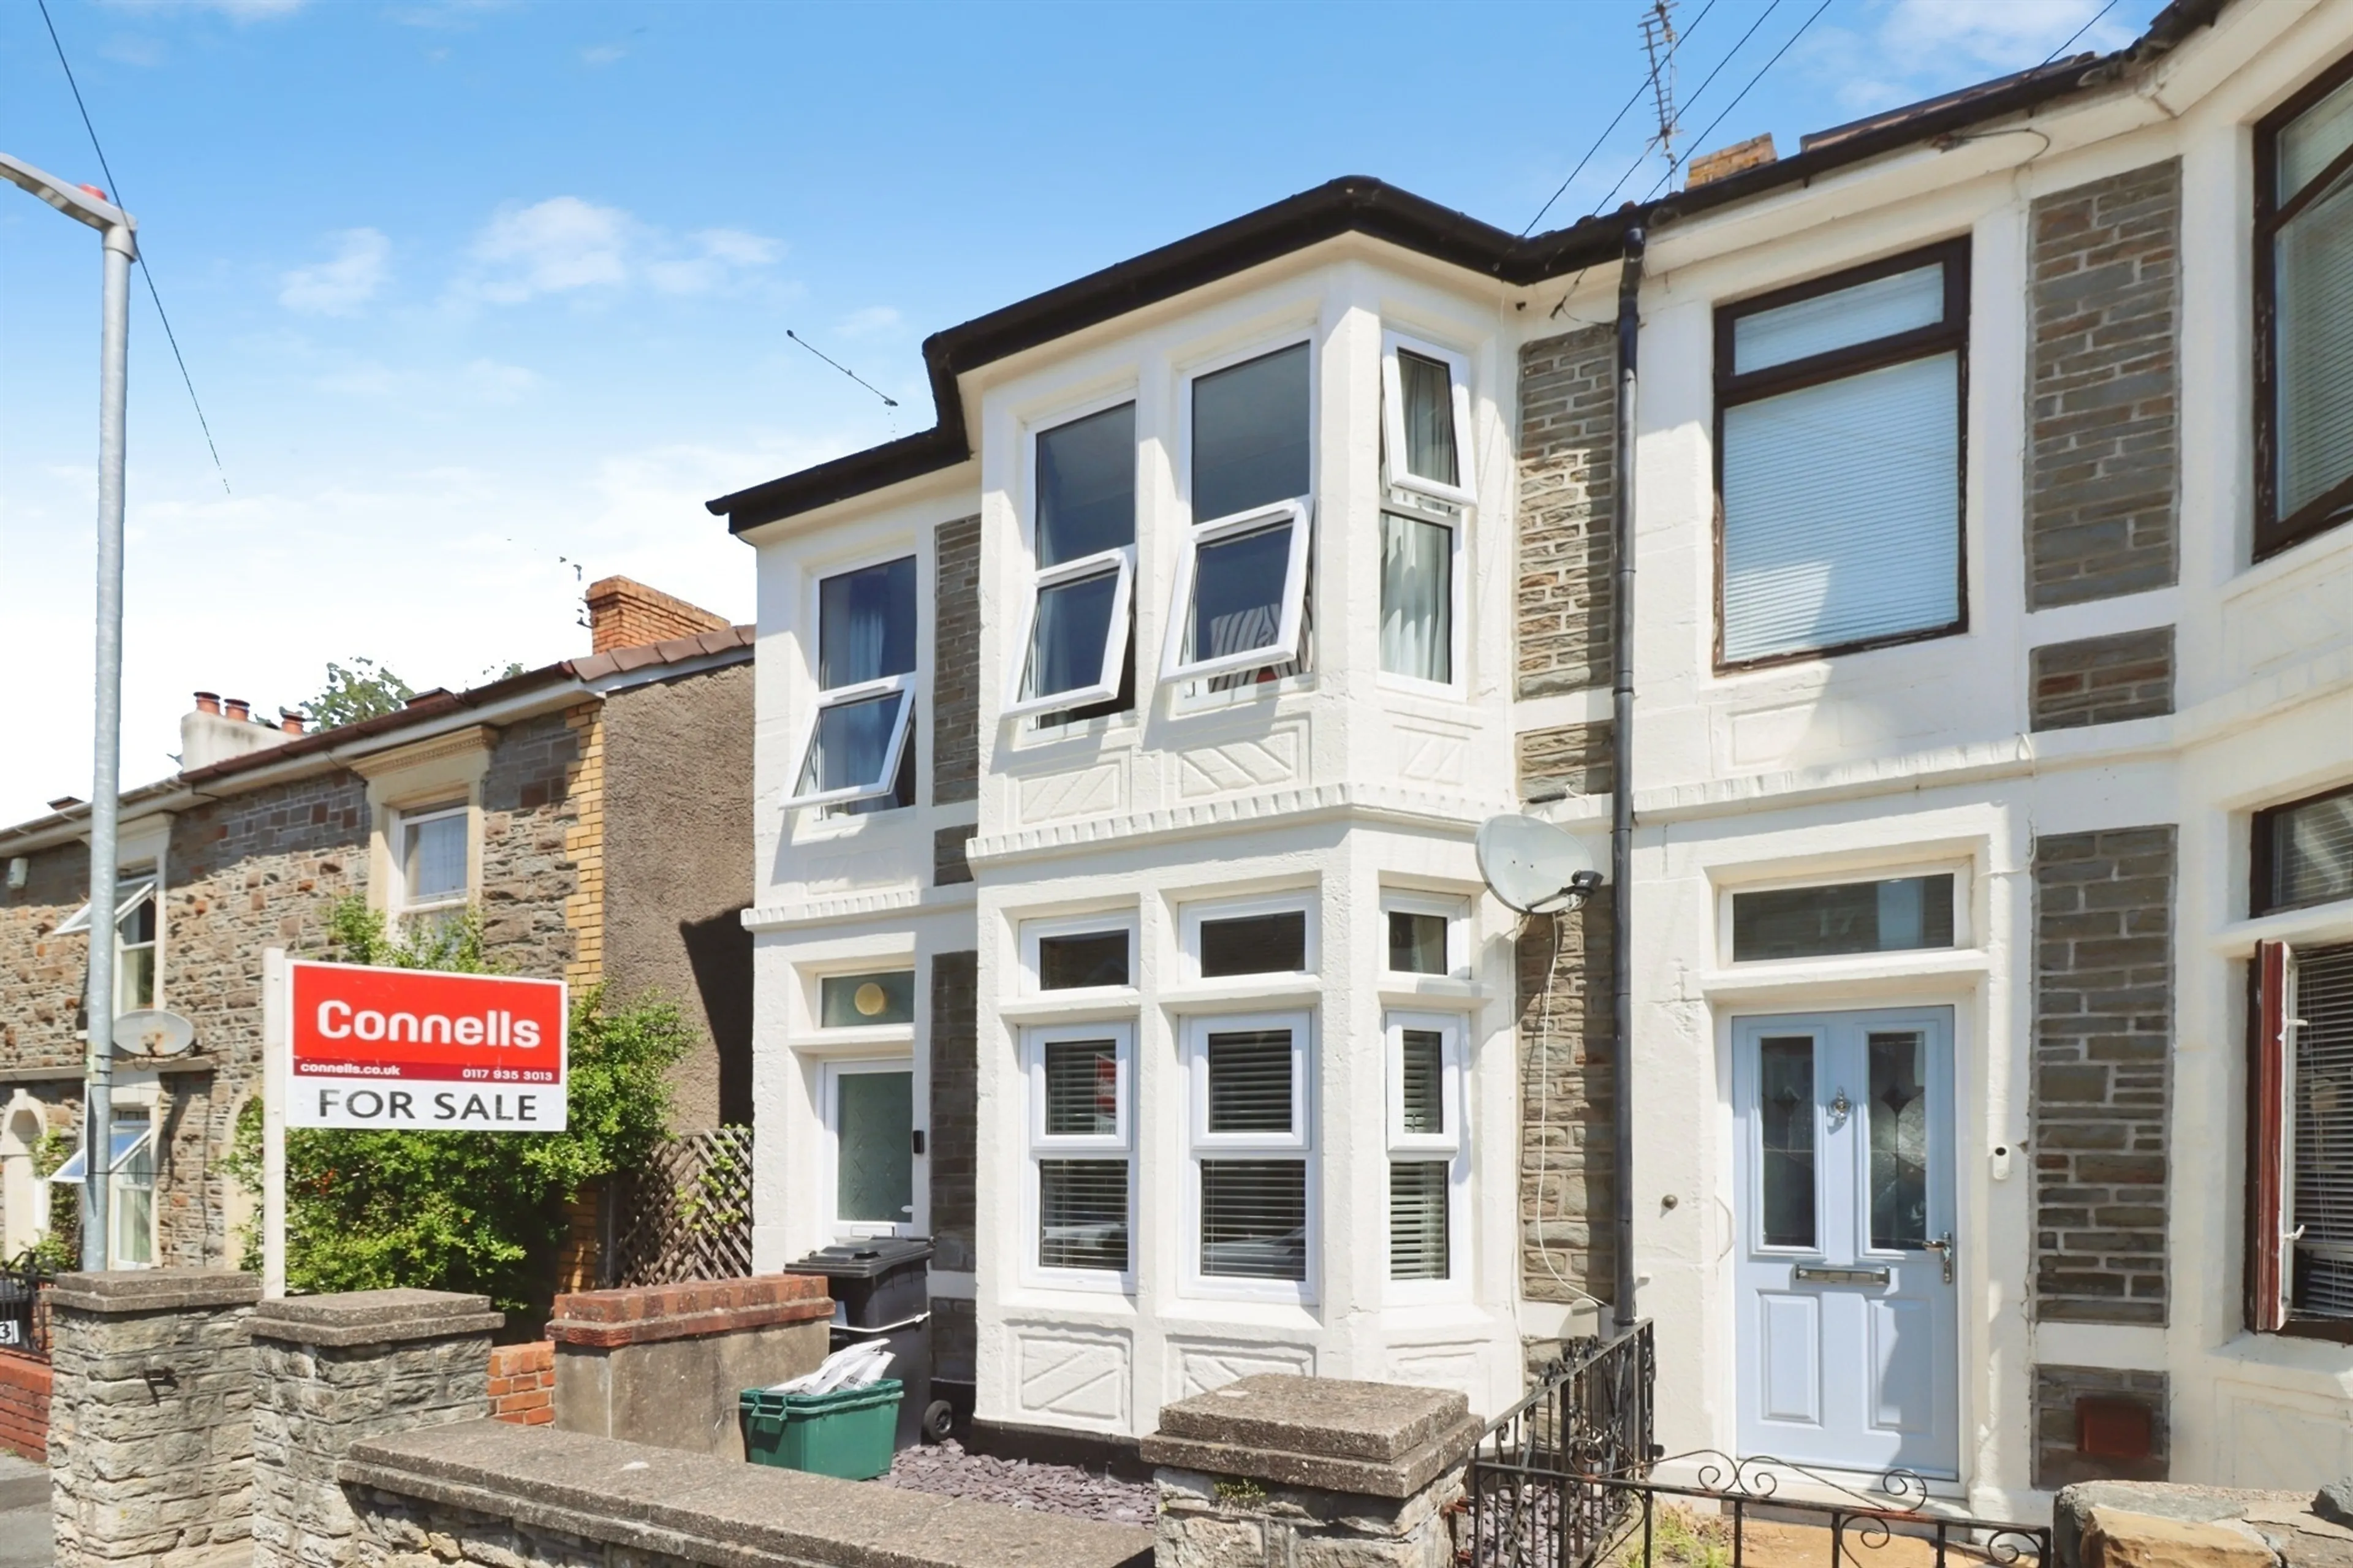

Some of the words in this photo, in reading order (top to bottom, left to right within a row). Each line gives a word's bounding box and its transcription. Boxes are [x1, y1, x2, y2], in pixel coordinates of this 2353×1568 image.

[317, 999, 541, 1048] Connells
[300, 1063, 401, 1075] connells.co.uk
[463, 1068, 489, 1078] 0117
[493, 1069, 519, 1080] 935
[523, 1070, 553, 1081] 3013
[319, 1089, 415, 1119] FOR
[433, 1092, 537, 1121] SALE
